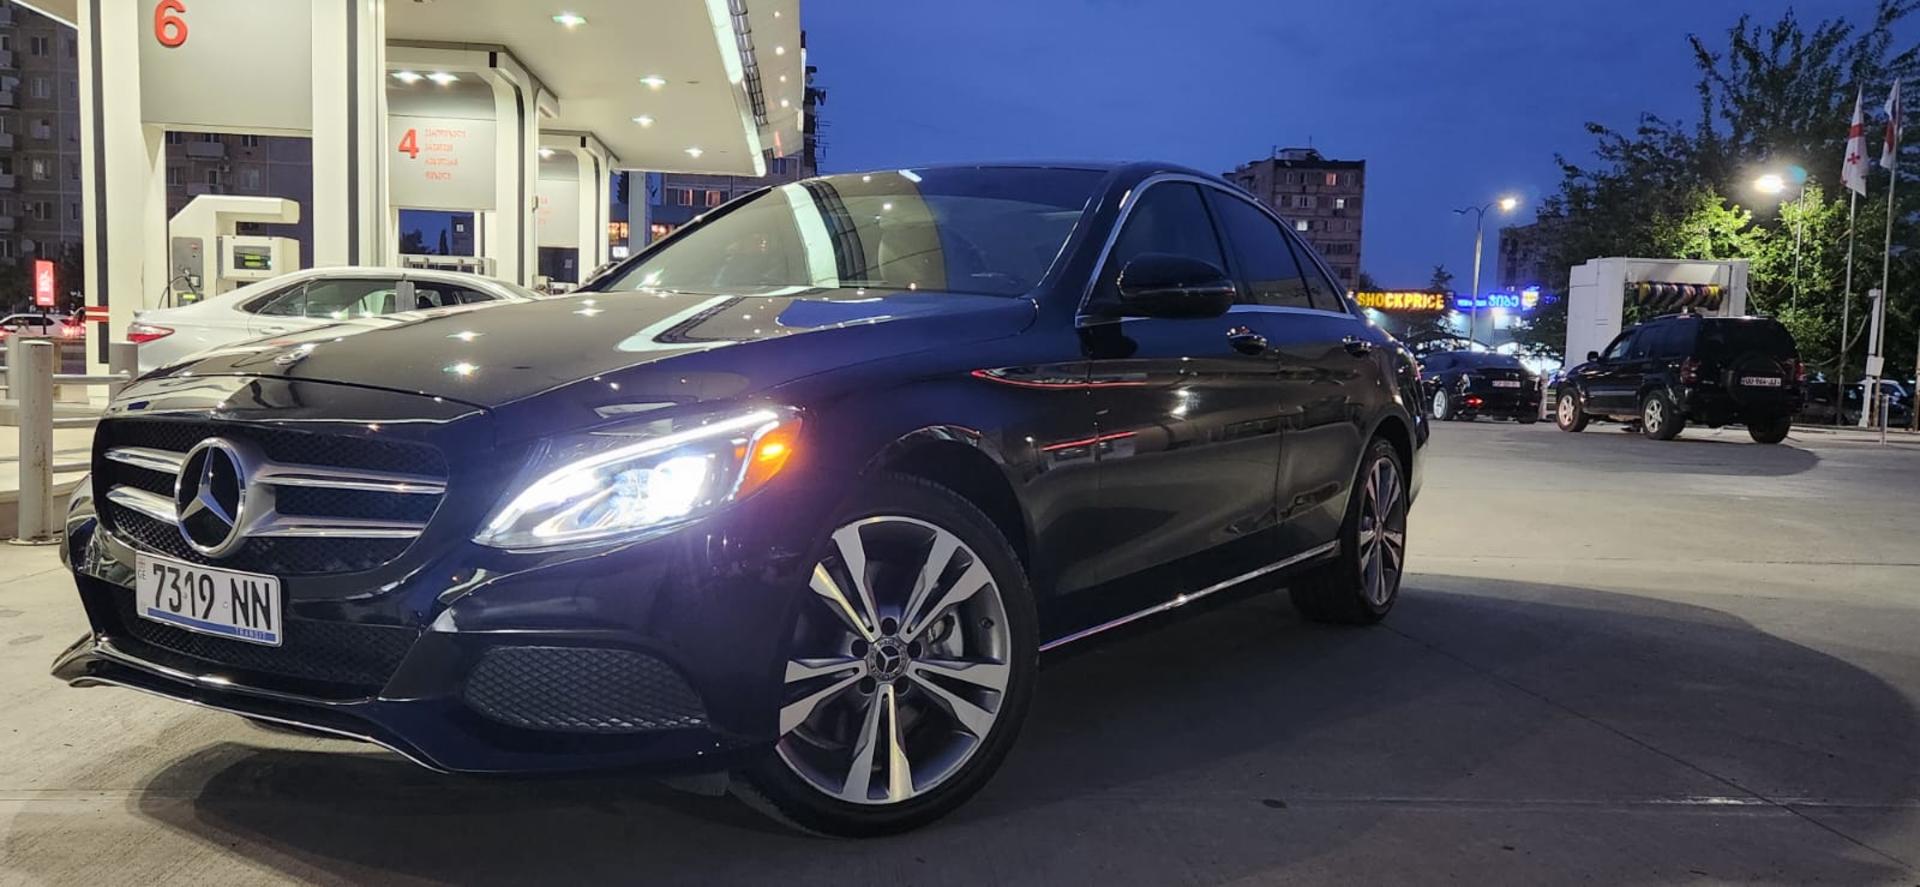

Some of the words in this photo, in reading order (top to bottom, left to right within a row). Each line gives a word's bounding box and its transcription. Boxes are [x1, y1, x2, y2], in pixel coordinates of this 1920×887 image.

[154, 0, 188, 48] 6
[398, 128, 420, 159] 4
[1357, 292, 1445, 310] SHOCKPRICE
[153, 564, 214, 620] 7319
[231, 577, 271, 631] NN
